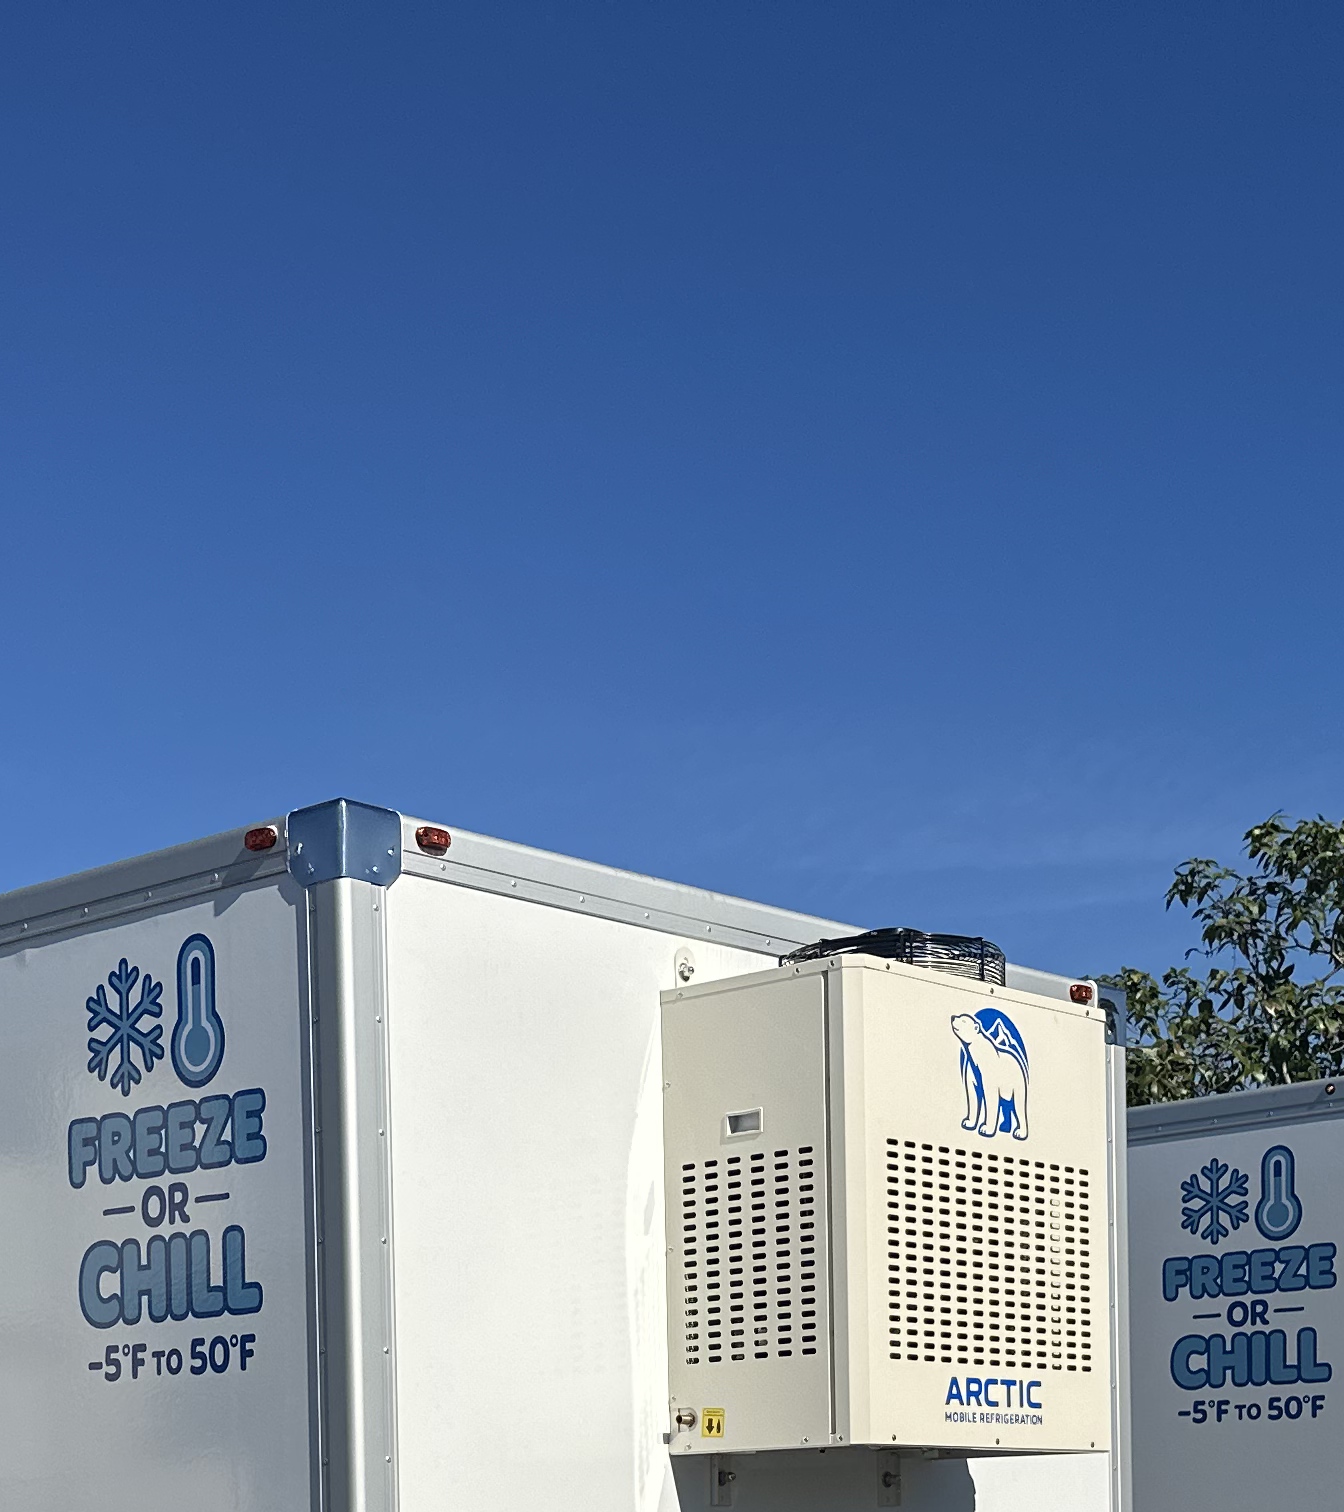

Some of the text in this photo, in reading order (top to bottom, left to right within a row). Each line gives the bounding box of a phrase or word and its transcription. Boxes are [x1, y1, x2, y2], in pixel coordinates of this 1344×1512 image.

[68, 1087, 267, 1189] FREEZE
[140, 1182, 190, 1228] OR
[78, 1224, 263, 1329] CHILL
[1162, 1242, 1337, 1302] FREEZE
[1226, 1299, 1269, 1327] OR
[88, 1333, 256, 1381] -5°F TO 50°F
[1170, 1326, 1332, 1391] CHILL
[945, 1376, 1042, 1409] ARCTIC
[1177, 1395, 1326, 1424] -5°F TO 50°F
[944, 1411, 1043, 1425] MOBILE REFRIGERATION
